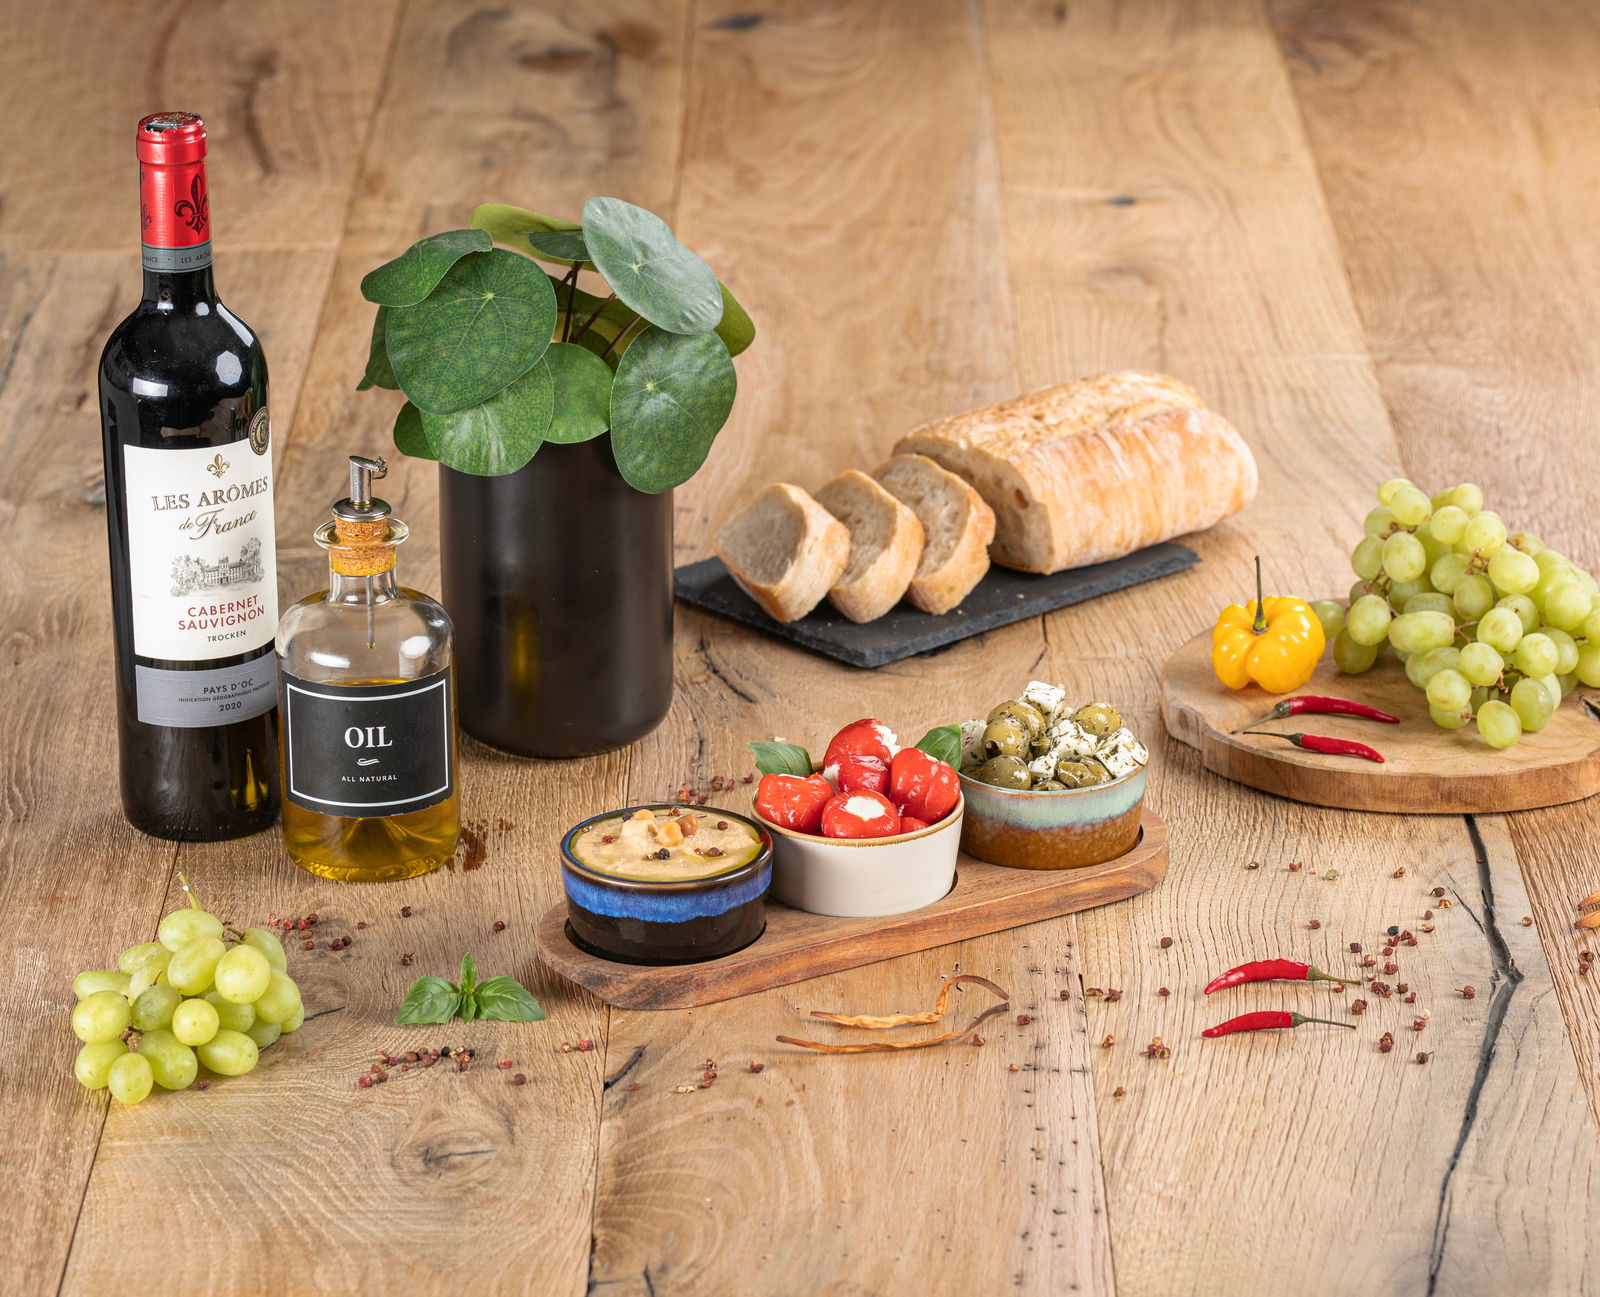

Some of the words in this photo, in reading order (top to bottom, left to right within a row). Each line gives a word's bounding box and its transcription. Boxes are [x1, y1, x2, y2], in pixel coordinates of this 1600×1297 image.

[181, 256, 192, 264] LES
[151, 494, 190, 511] LES
[197, 476, 268, 507] ARÔMES
[178, 517, 194, 530] de
[189, 507, 257, 540] France
[187, 595, 258, 617] CABERNET
[178, 605, 265, 630] SAUVIGNON
[207, 629, 246, 642] TROCKEN
[203, 685, 228, 695] PAYS
[231, 678, 253, 691] D'OC
[219, 701, 242, 712] 2020
[344, 726, 393, 748] OIL
[359, 774, 397, 782] NATURAL
